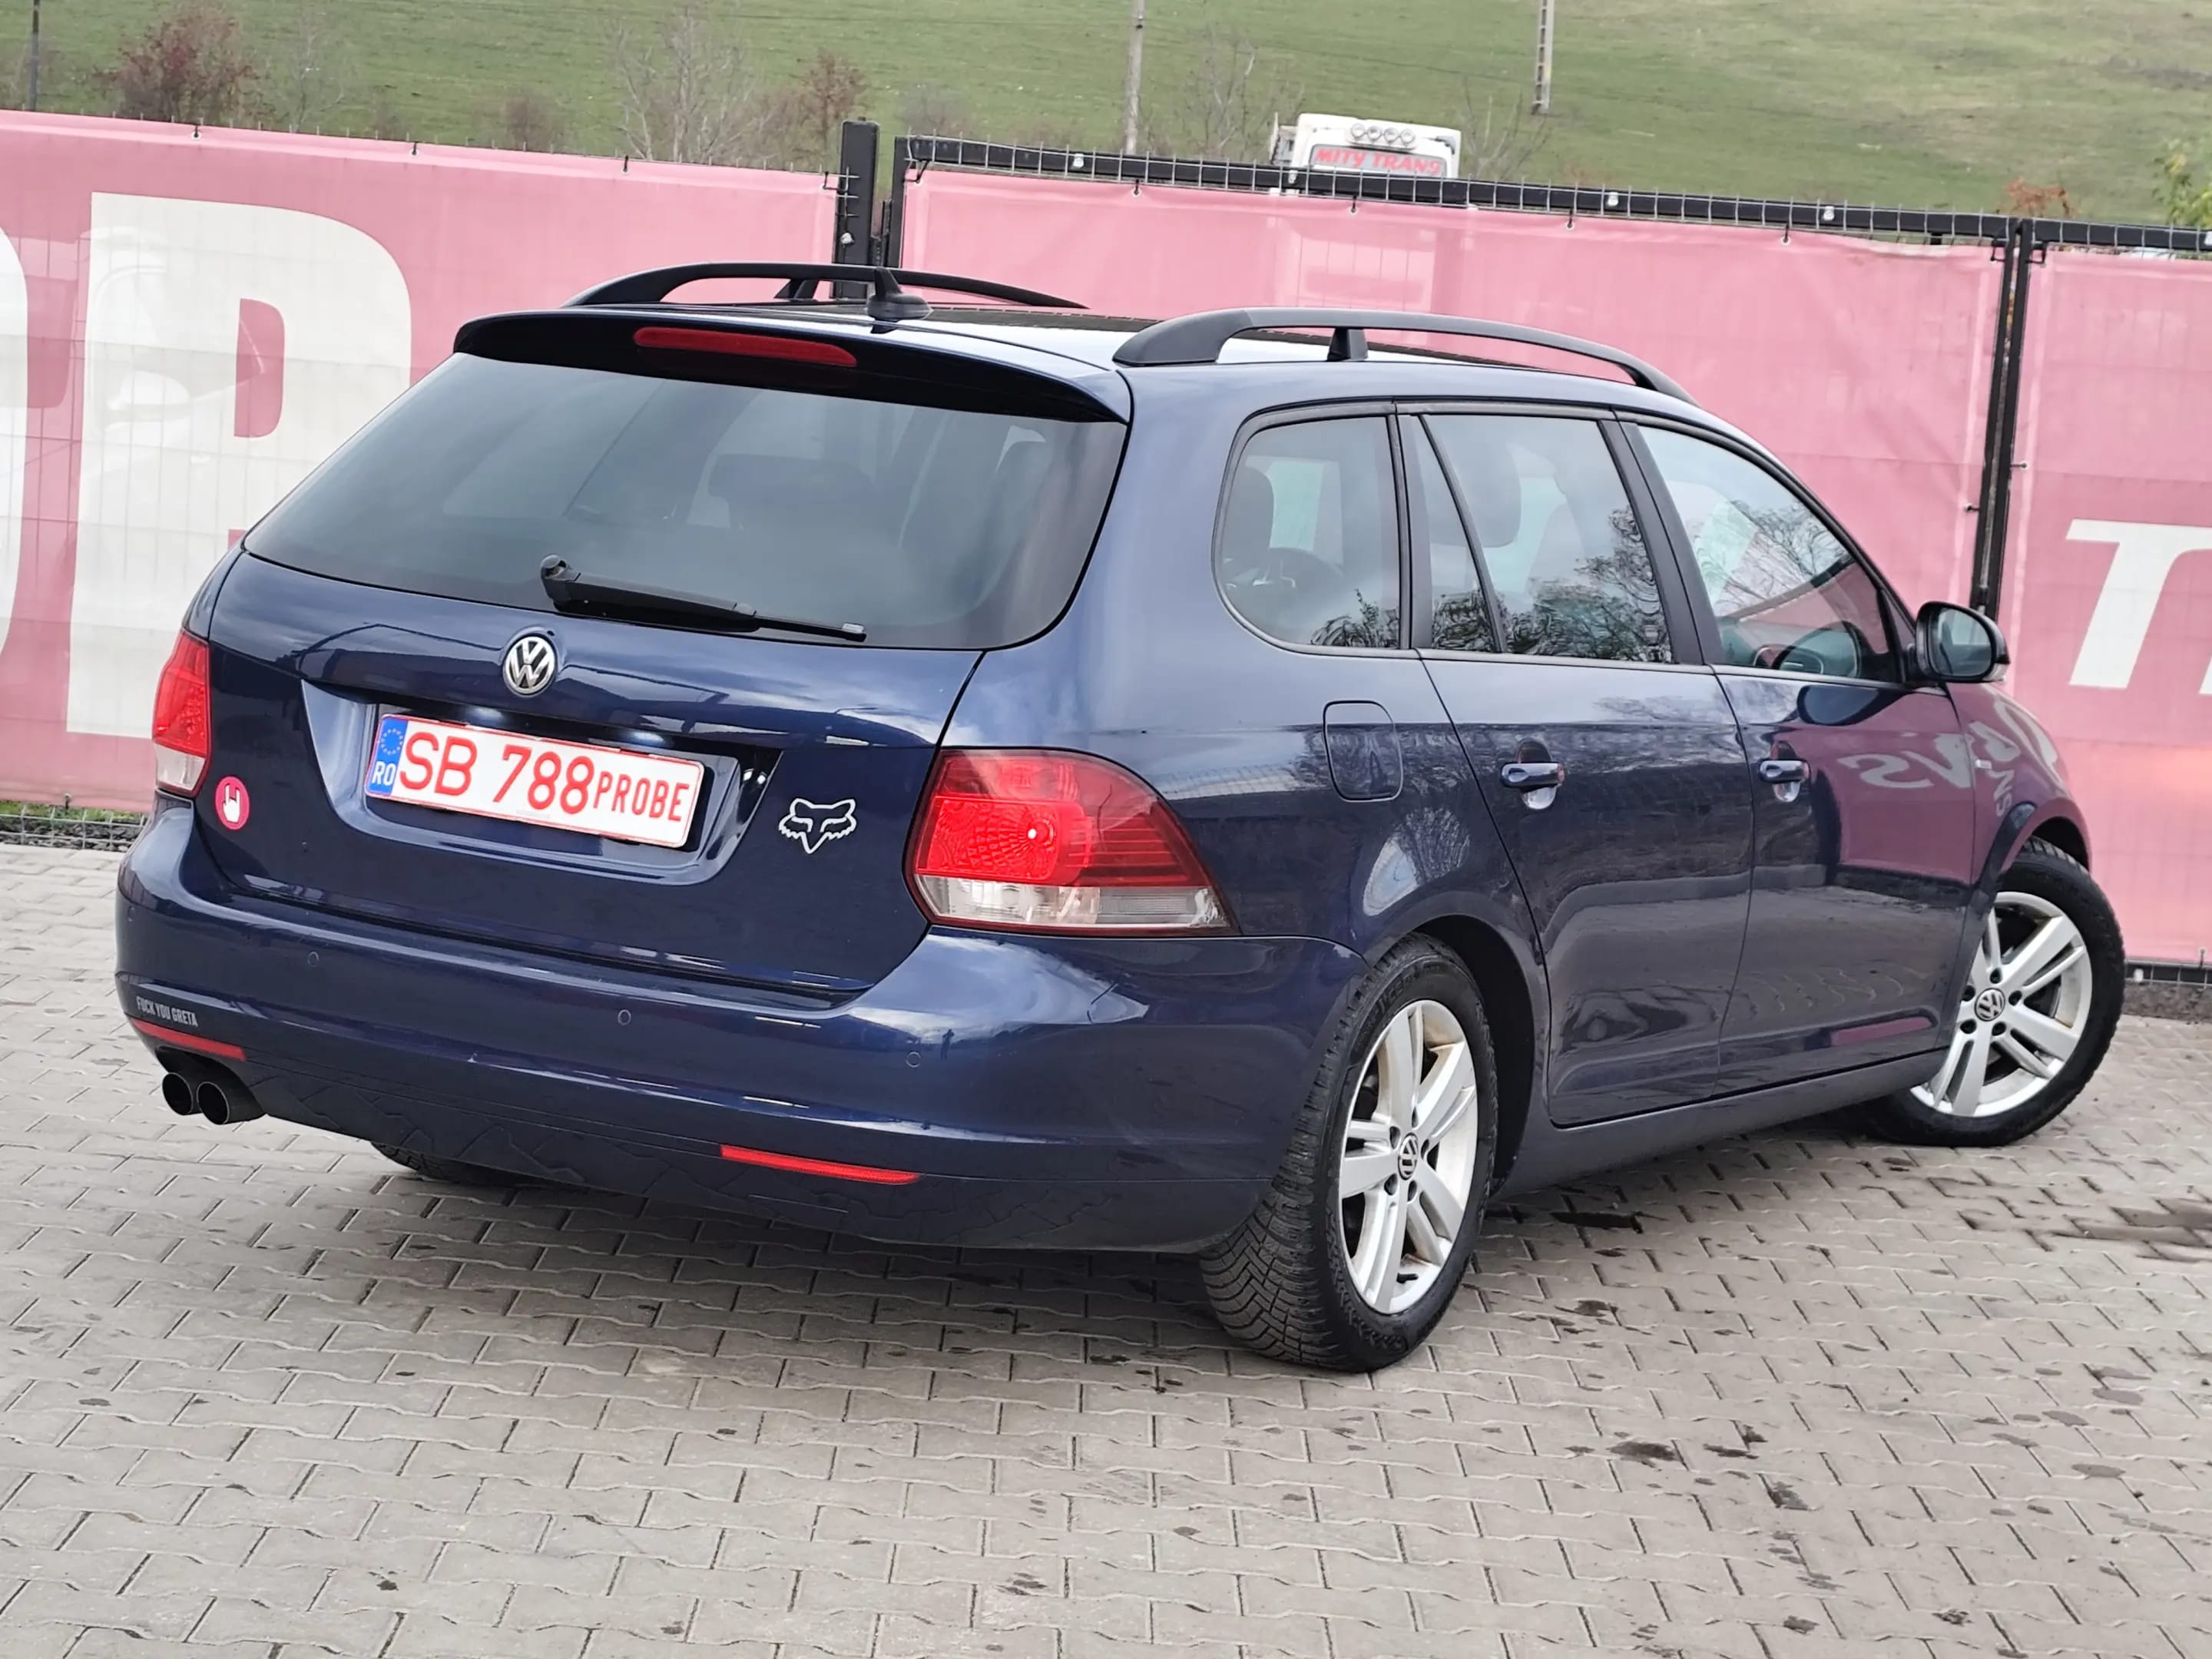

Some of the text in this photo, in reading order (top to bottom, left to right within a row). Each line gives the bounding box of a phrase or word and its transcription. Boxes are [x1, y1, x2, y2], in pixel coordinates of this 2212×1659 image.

[1371, 153, 1442, 176] TRANS
[2066, 518, 2212, 696] T
[371, 760, 396, 787] RO
[399, 730, 690, 822] SB 788 PROBE
